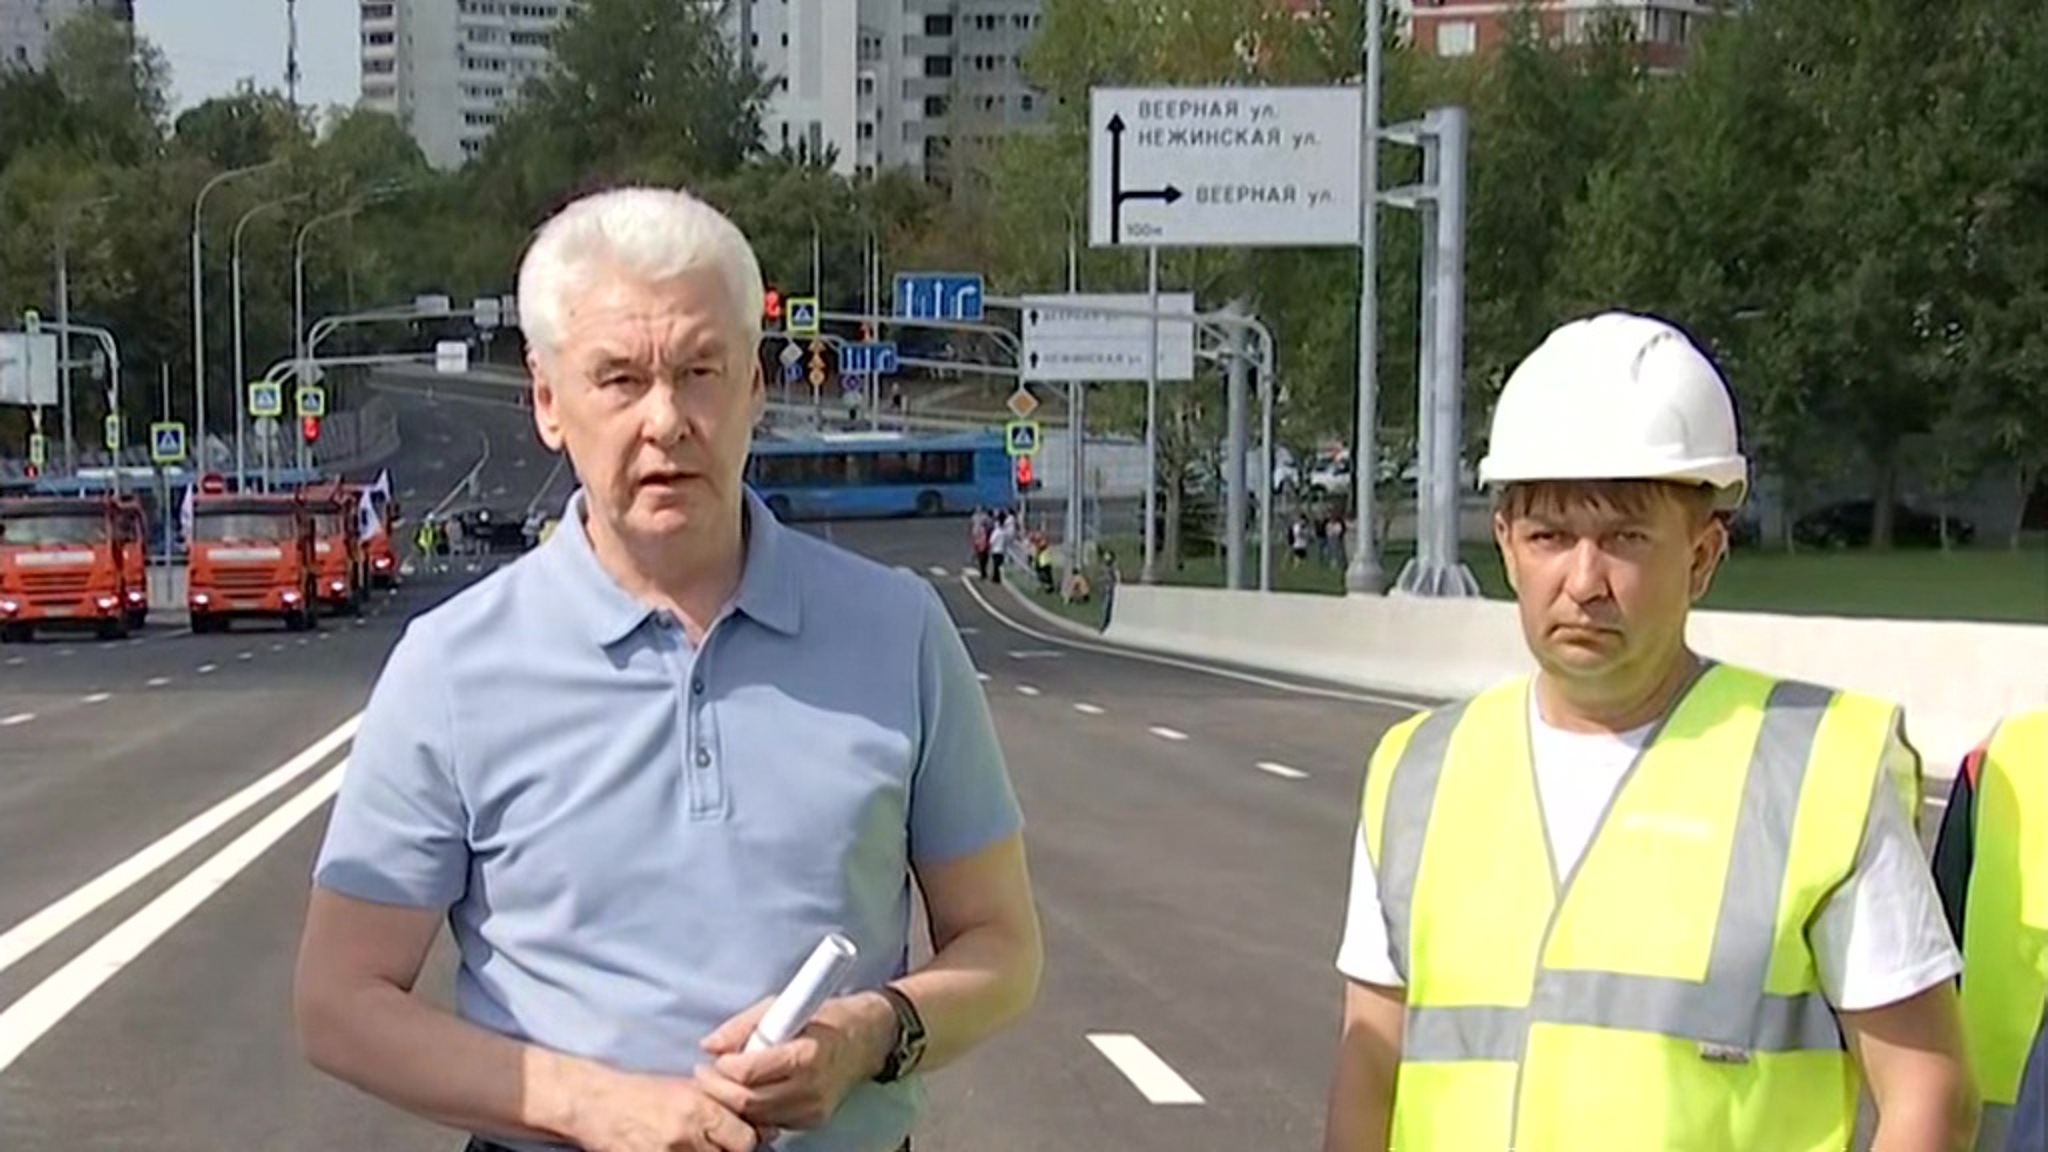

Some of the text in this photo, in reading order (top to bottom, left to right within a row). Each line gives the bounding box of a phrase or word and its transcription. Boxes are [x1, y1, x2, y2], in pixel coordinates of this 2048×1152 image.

[1138, 101, 1277, 121] ВЕЕРНАЯ ул.
[1138, 128, 1281, 146] НЕЖИНСКАЯ
[1196, 185, 1296, 204] ВЕЕРНАЯ
